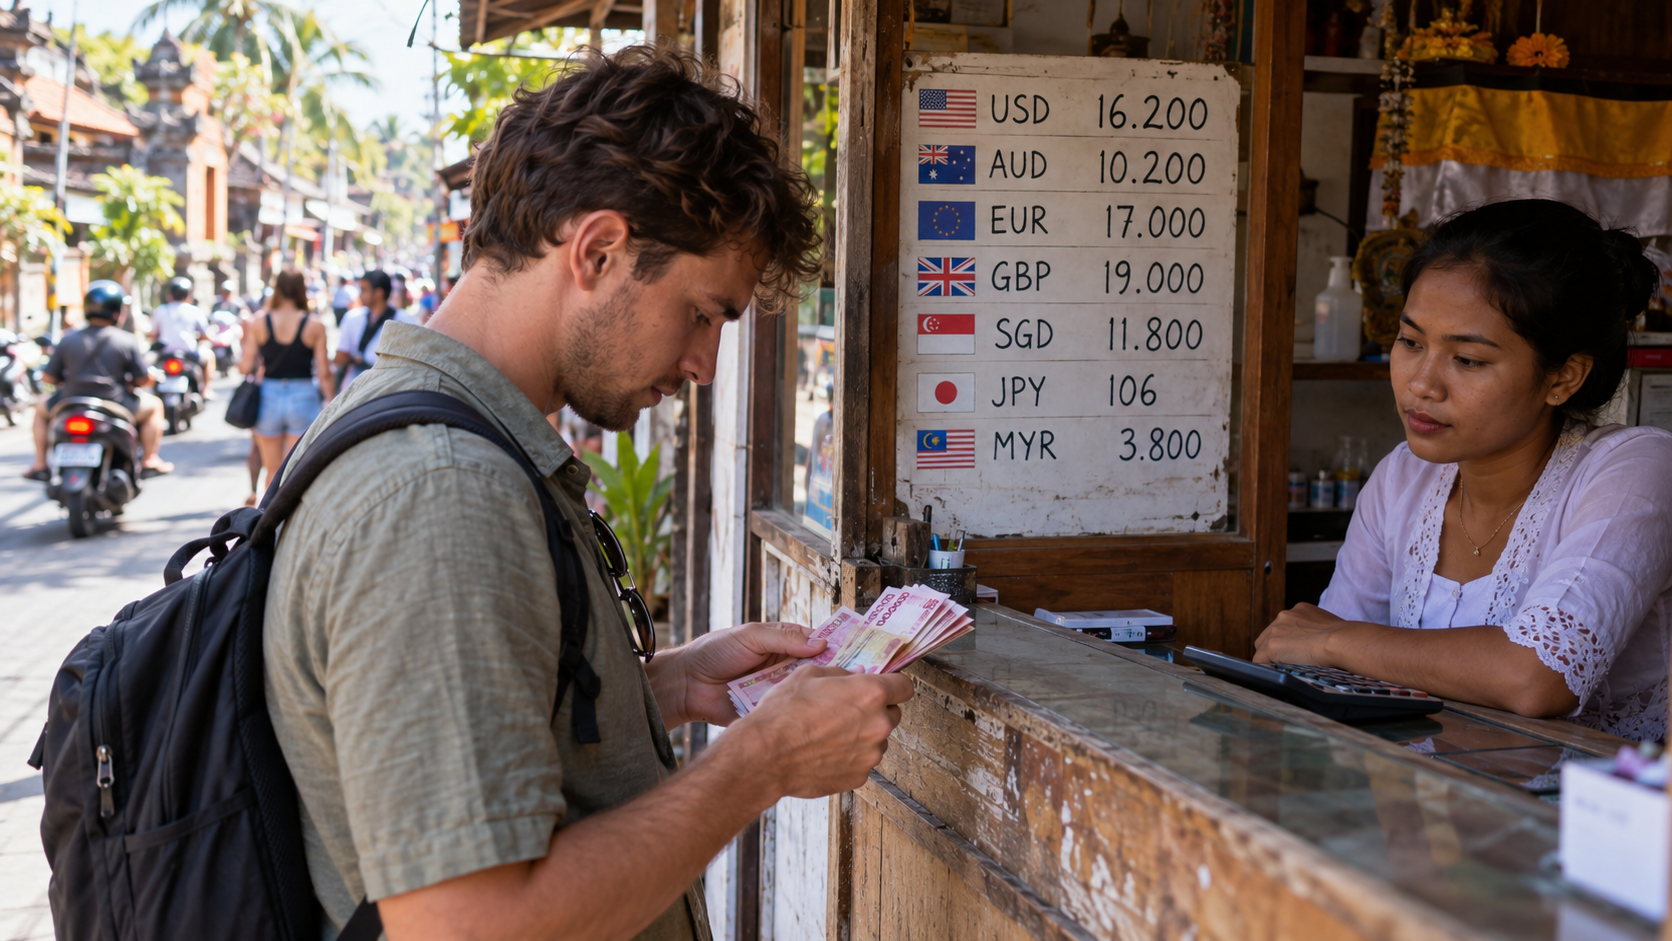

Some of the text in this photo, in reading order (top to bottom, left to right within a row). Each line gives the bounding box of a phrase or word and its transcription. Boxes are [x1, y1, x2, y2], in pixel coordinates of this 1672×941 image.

[991, 94, 1208, 131] USD 16.200
[989, 149, 1206, 185] AUD 10.200
[991, 205, 1206, 239] EUR 17.000
[992, 260, 1204, 295] GBP 19.000
[995, 317, 1203, 353] SGD 11.800
[992, 374, 1157, 408] JPY 106
[994, 427, 1202, 462] MYR 3.800
